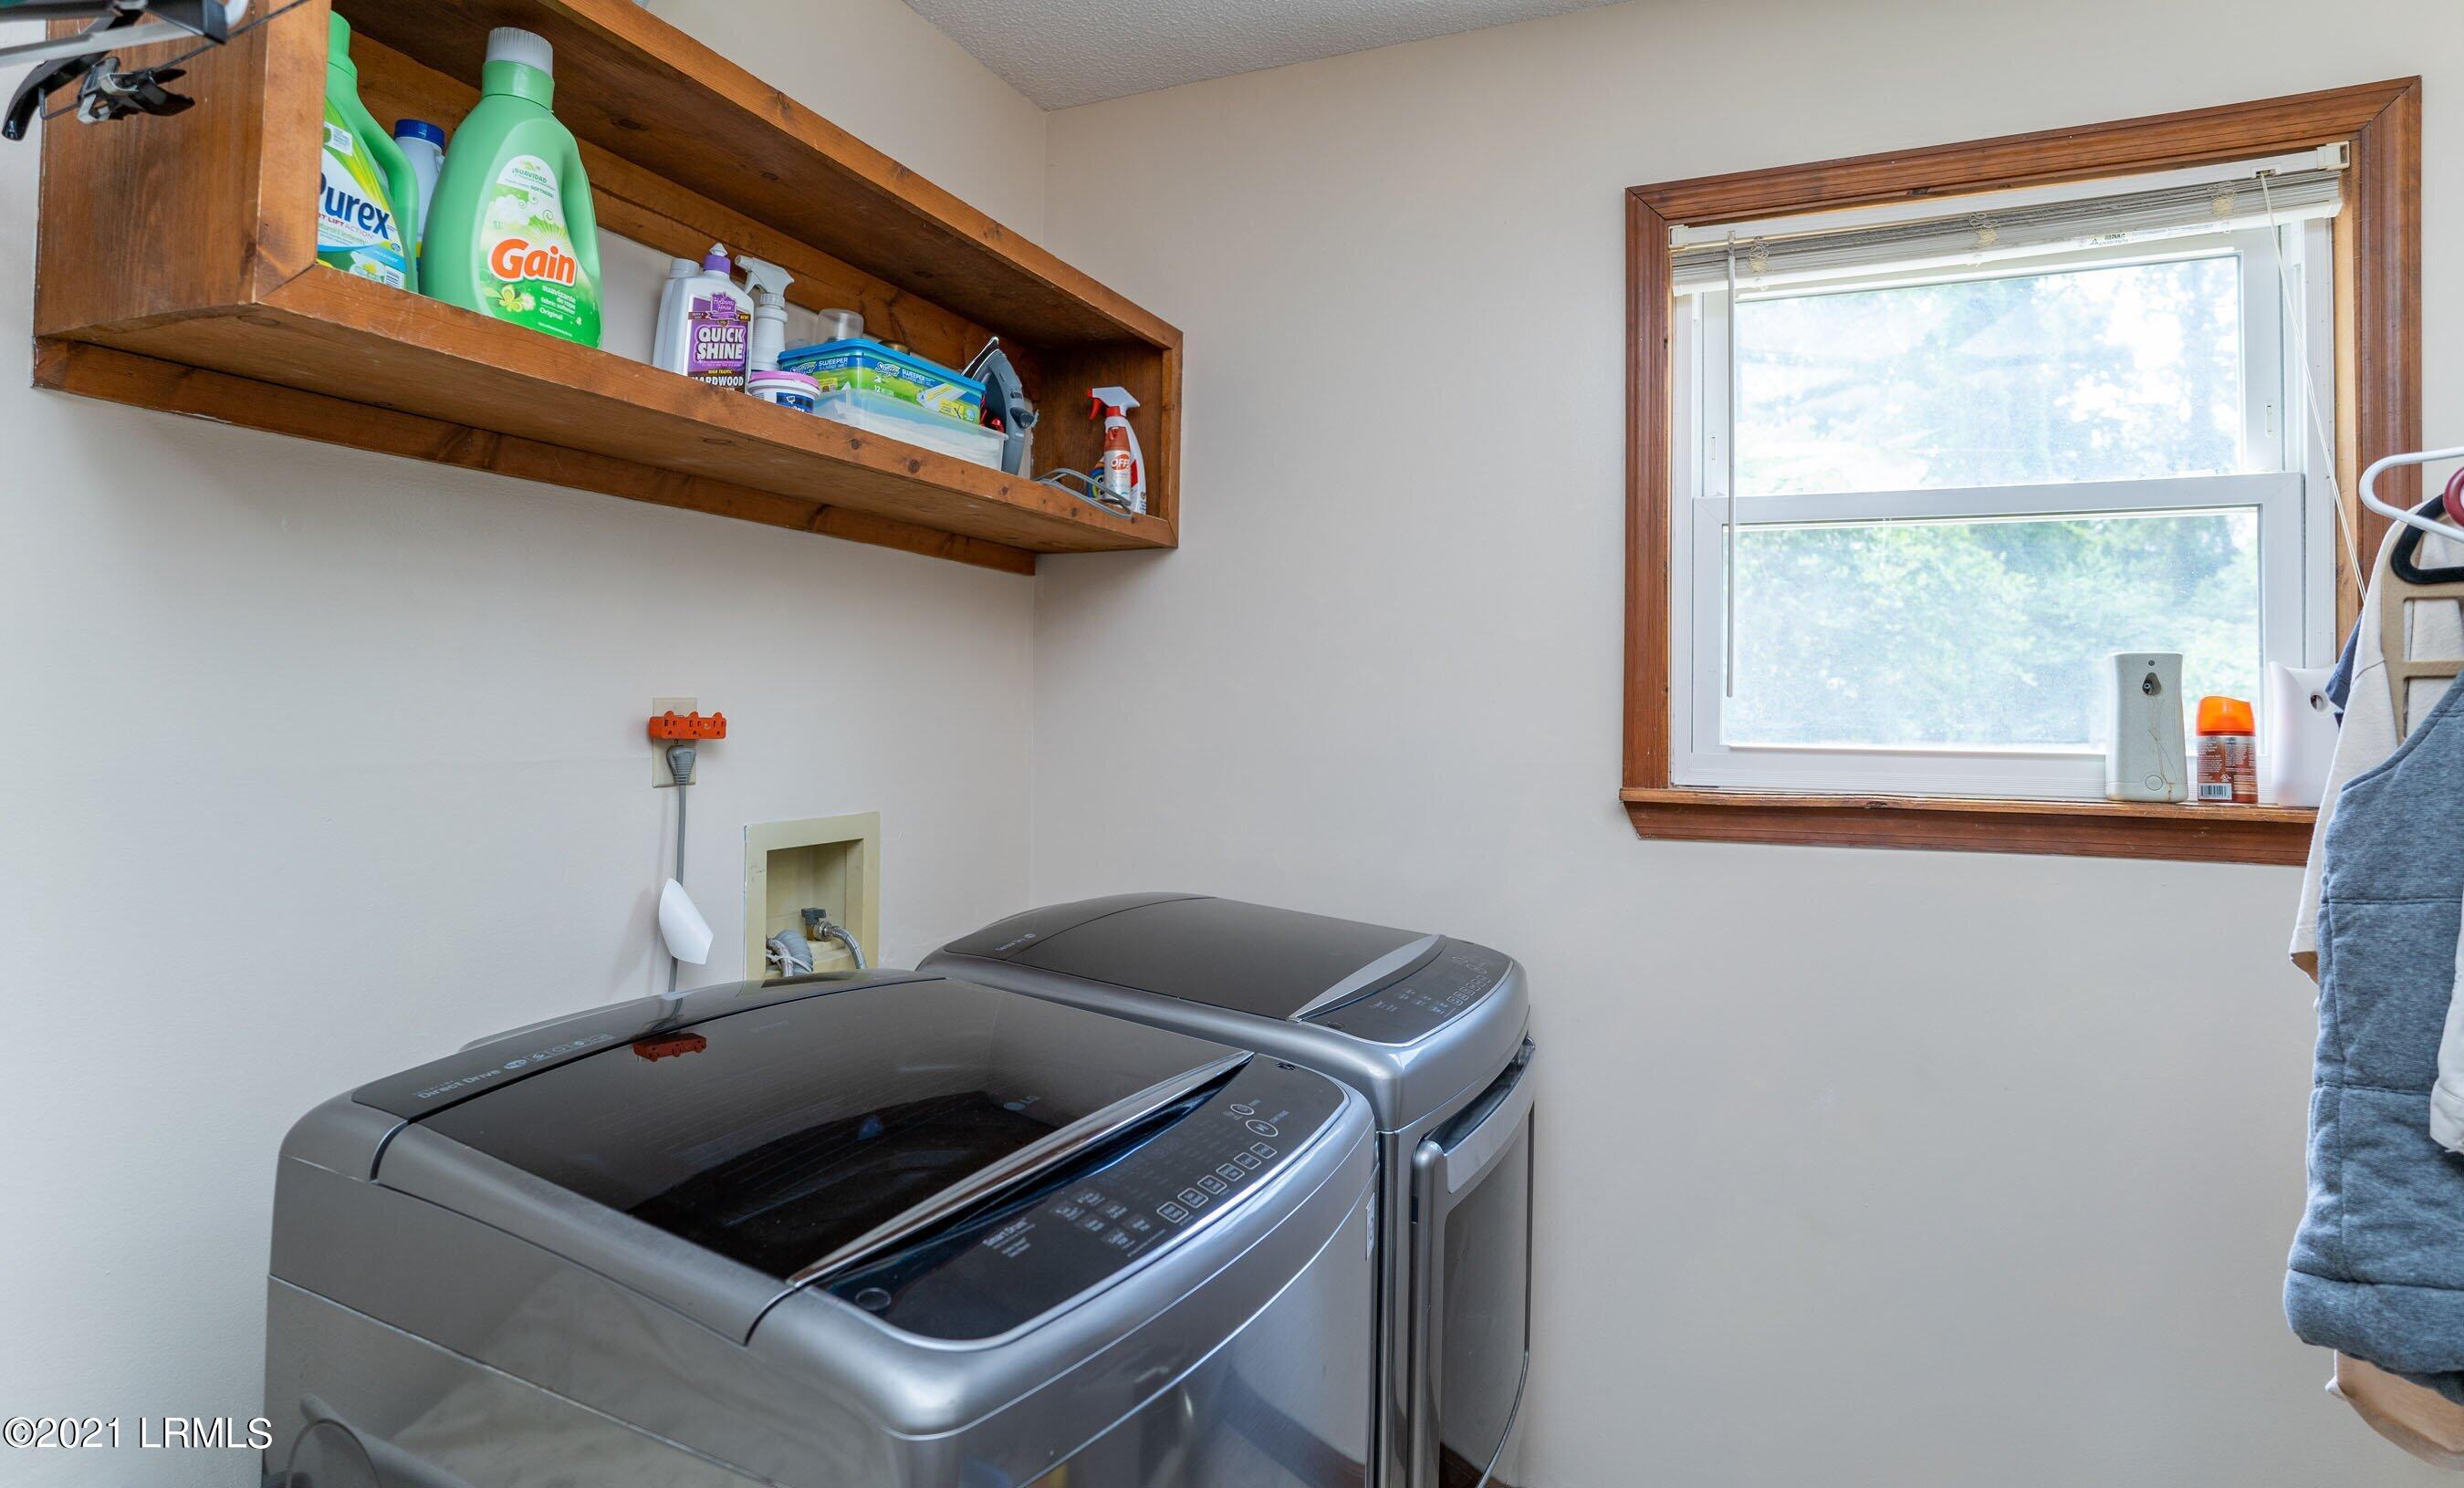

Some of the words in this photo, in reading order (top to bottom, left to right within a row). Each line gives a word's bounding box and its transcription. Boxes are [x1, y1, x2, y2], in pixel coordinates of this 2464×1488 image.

[491, 238, 576, 285] Gain
[539, 307, 563, 321] Original
[697, 327, 745, 343] QUICK
[696, 342, 744, 360] SHINE
[818, 357, 849, 367] SWEEPER
[875, 361, 902, 378] Swiffer
[902, 369, 925, 382] SWEEPER
[874, 385, 882, 393] 12
[418, 1081, 463, 1098] Direct
[463, 1069, 501, 1083] Drive
